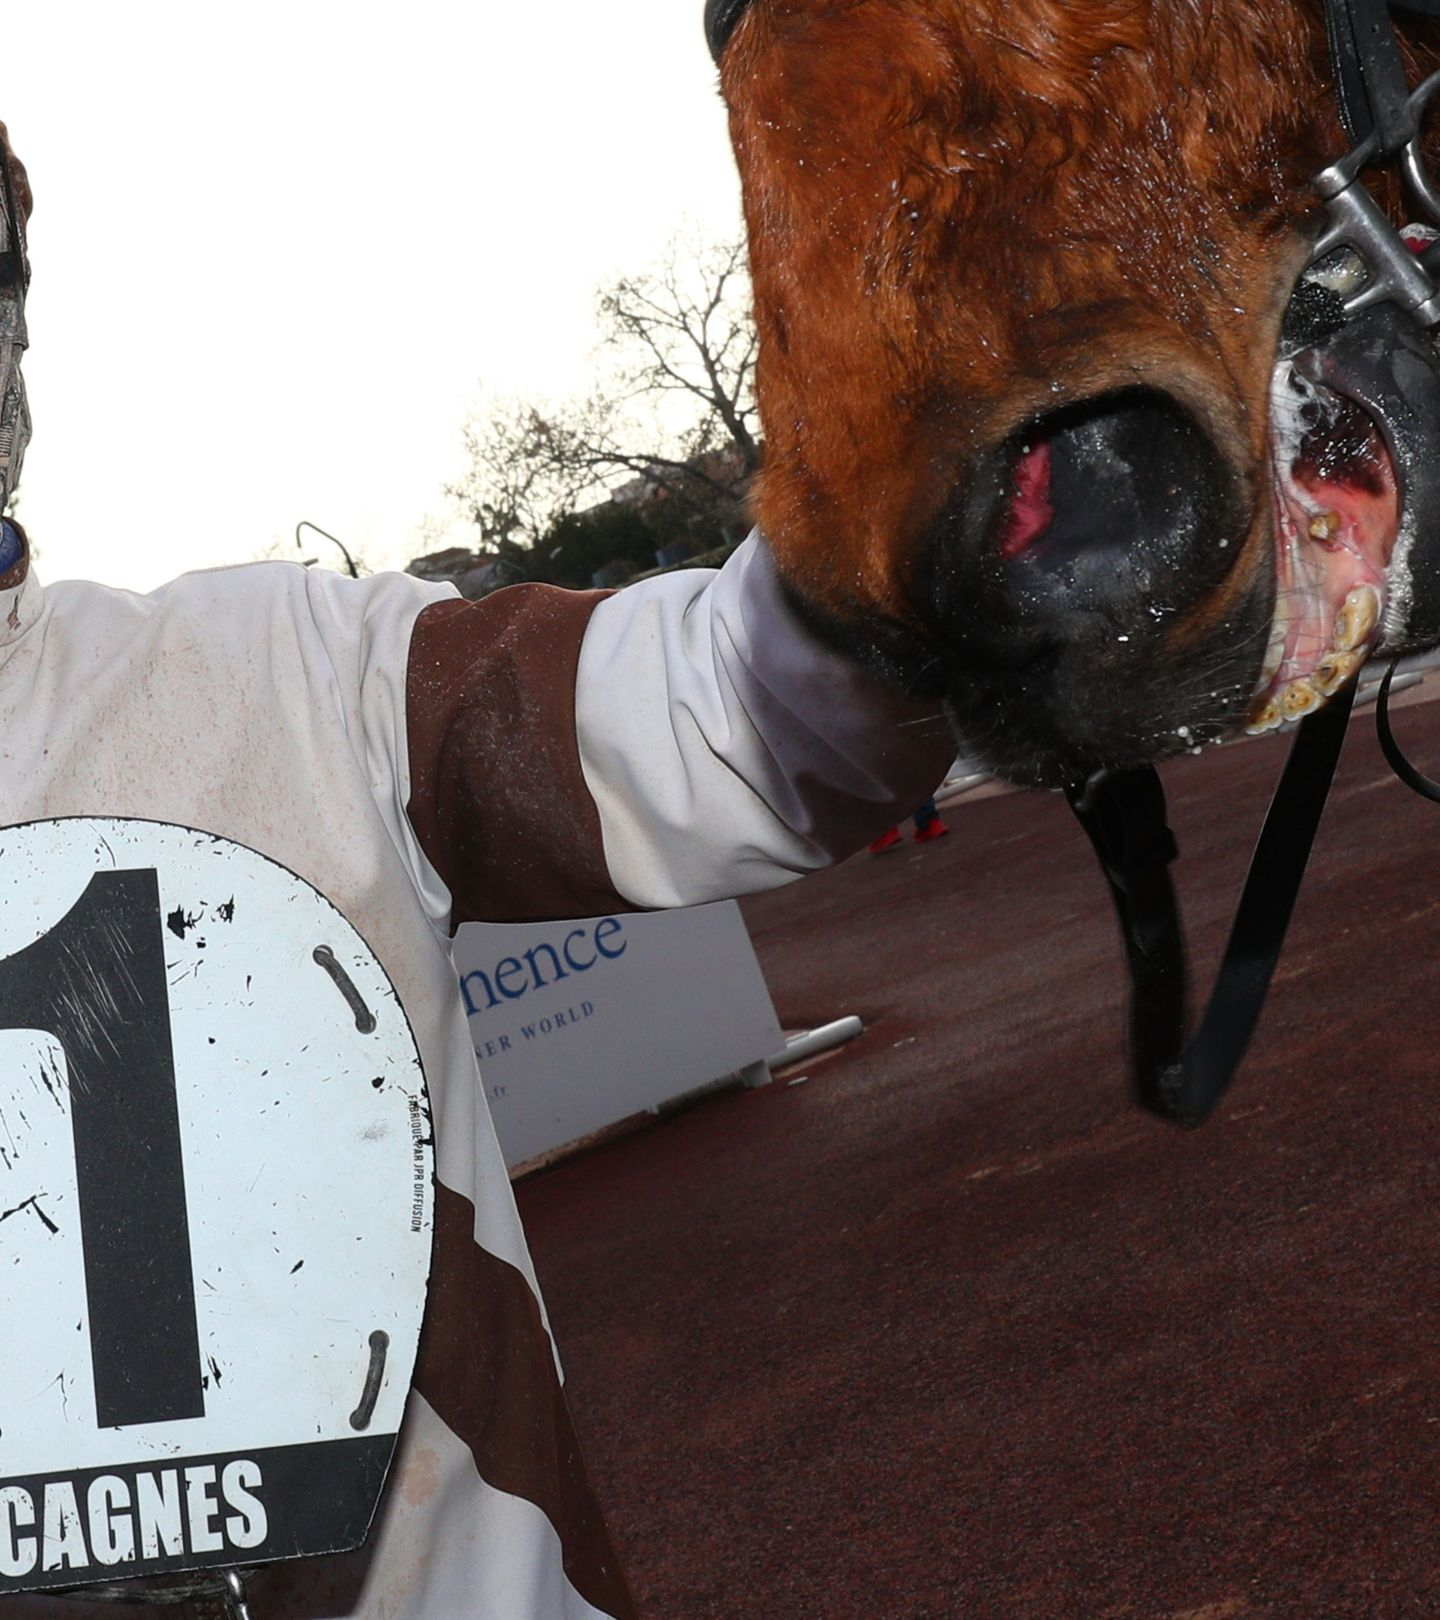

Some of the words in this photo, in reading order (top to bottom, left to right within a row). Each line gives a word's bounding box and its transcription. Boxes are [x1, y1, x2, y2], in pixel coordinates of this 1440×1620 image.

[520, 1000, 595, 1042] WORLD
[413, 1141, 424, 1161] PAR
[413, 1163, 425, 1181] JPR
[411, 1183, 425, 1233] DIFFUSION
